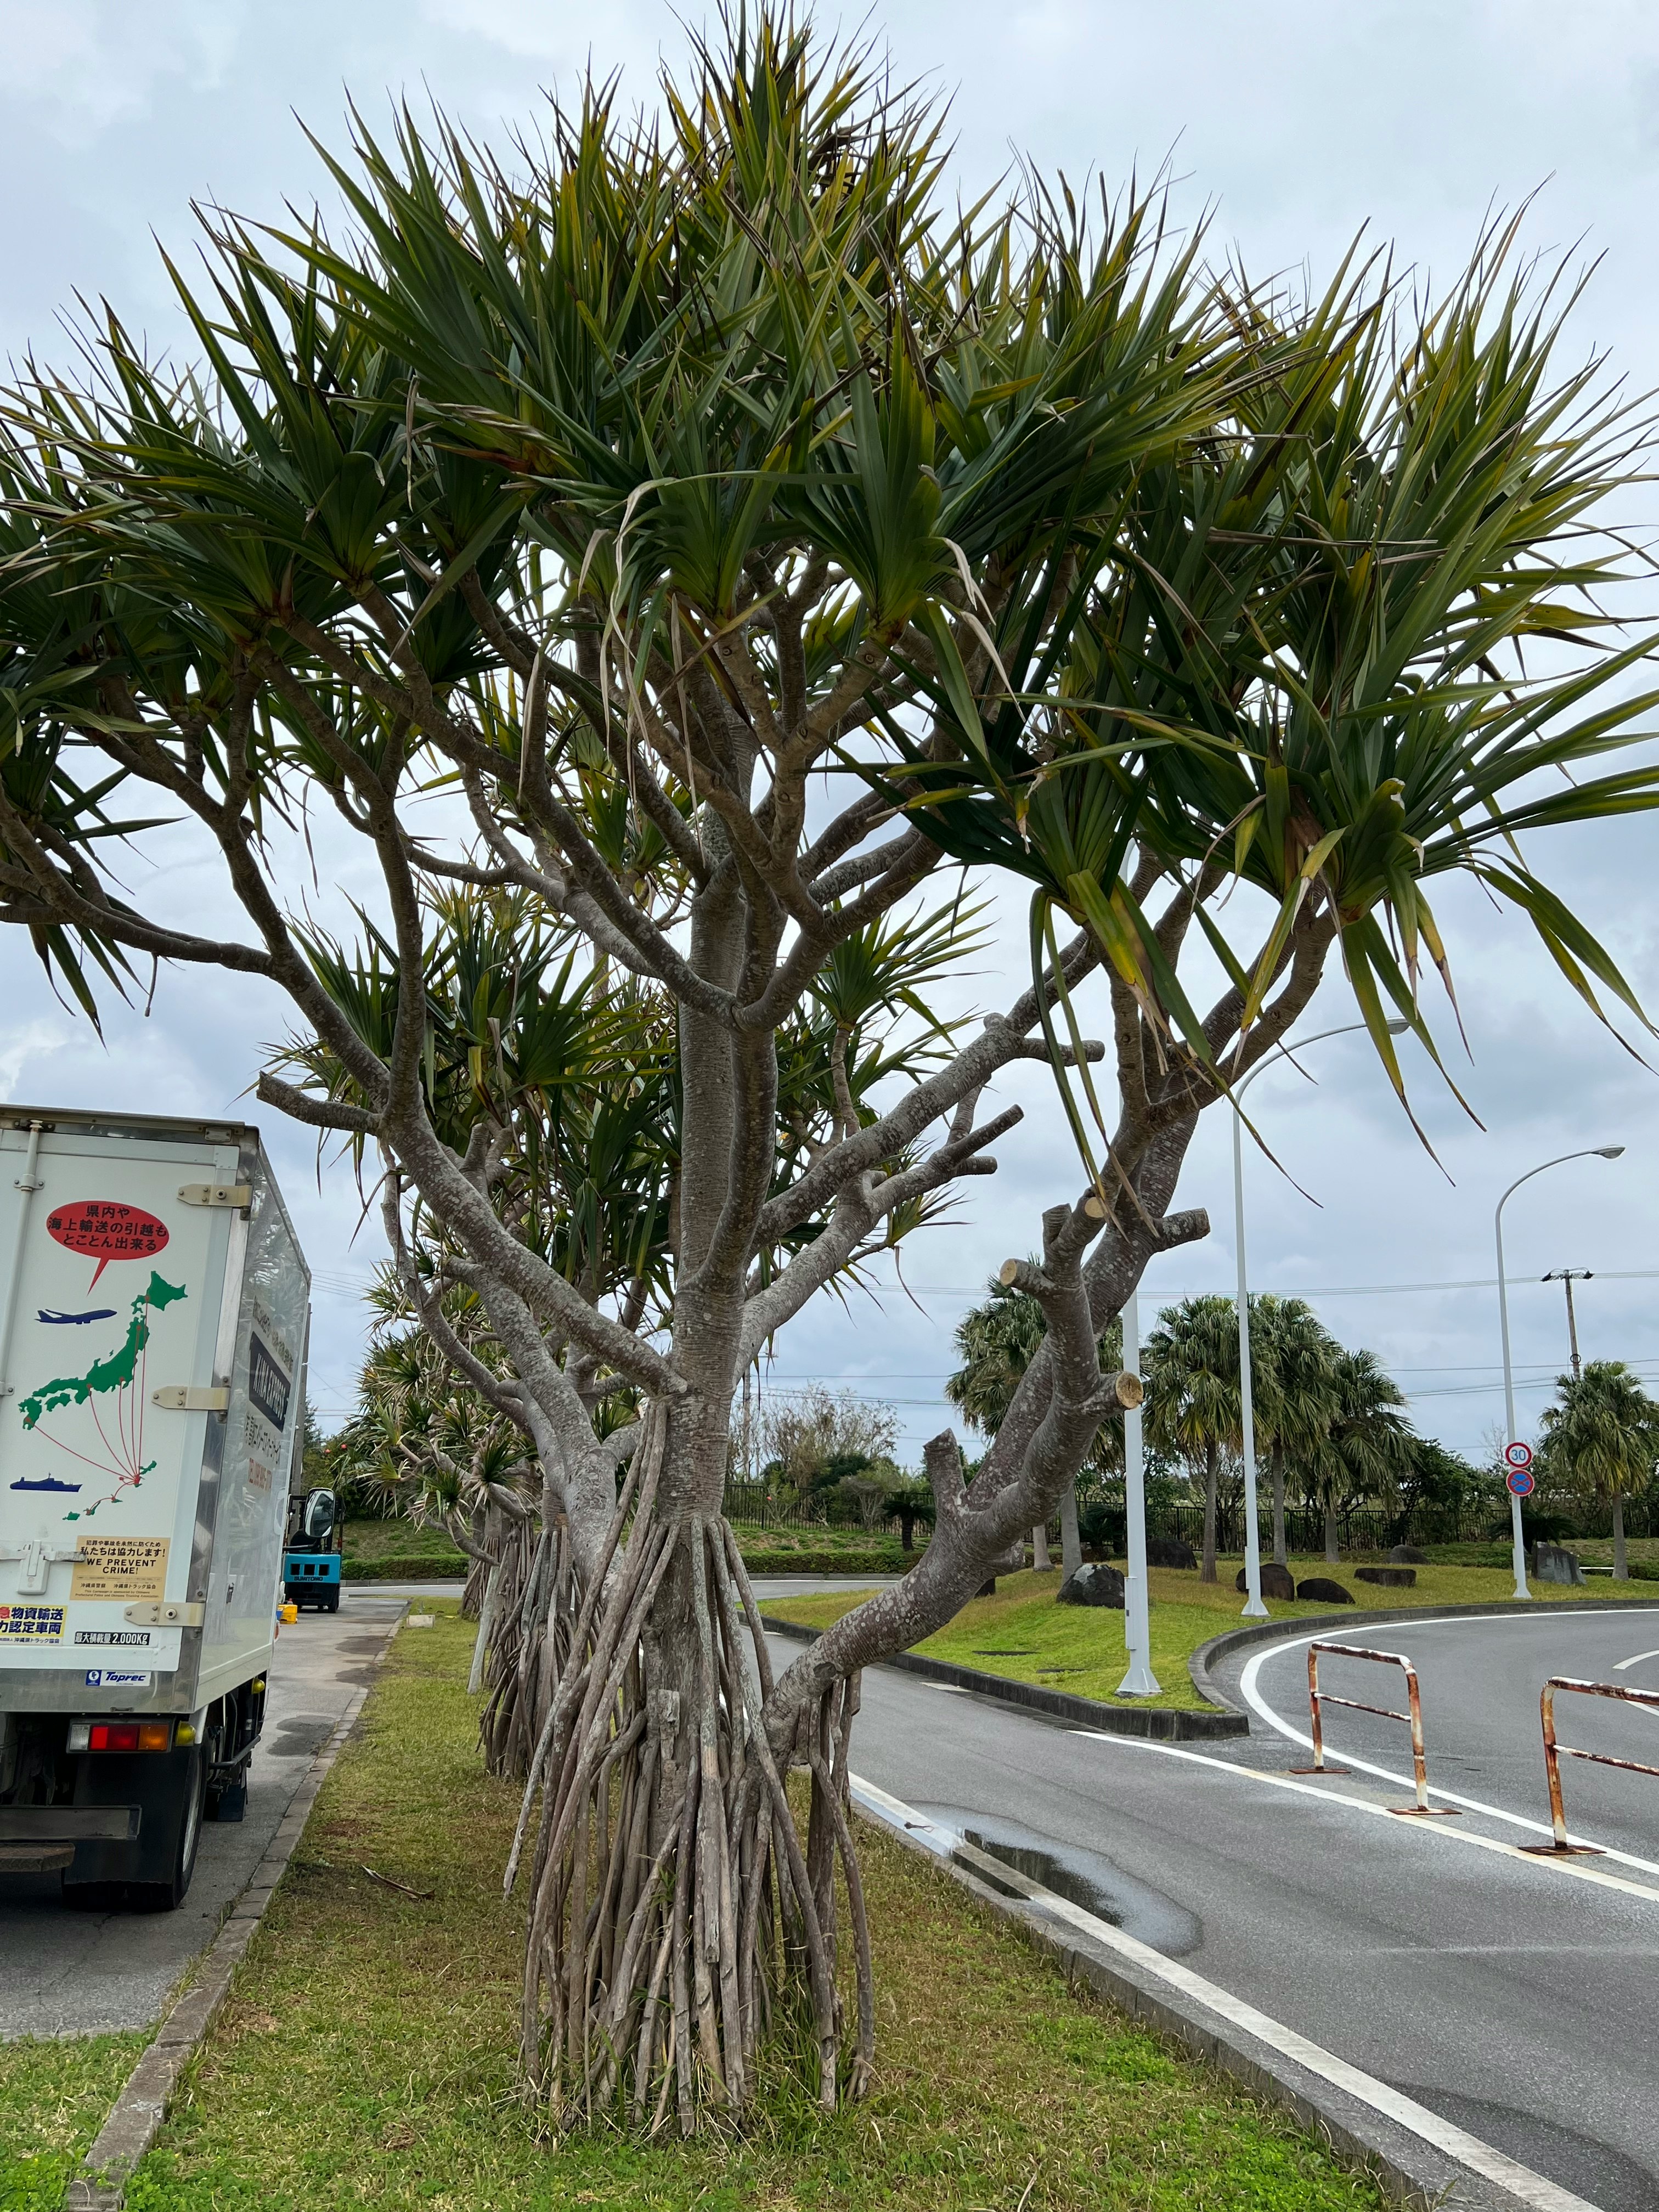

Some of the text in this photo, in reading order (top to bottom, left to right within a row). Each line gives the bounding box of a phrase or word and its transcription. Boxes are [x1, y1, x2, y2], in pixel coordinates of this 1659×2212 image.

[86, 1205, 130, 1219] 県内や
[47, 1217, 167, 1237] 海上輸送の引越も
[63, 1234, 157, 1251] とことん出来る
[1511, 1449, 1526, 1461] 30
[107, 1559, 156, 1567] PREVENT
[103, 1566, 138, 1575] CRIME!
[75, 1632, 111, 1644] 最大積載量
[105, 1672, 146, 1682] Toprec
